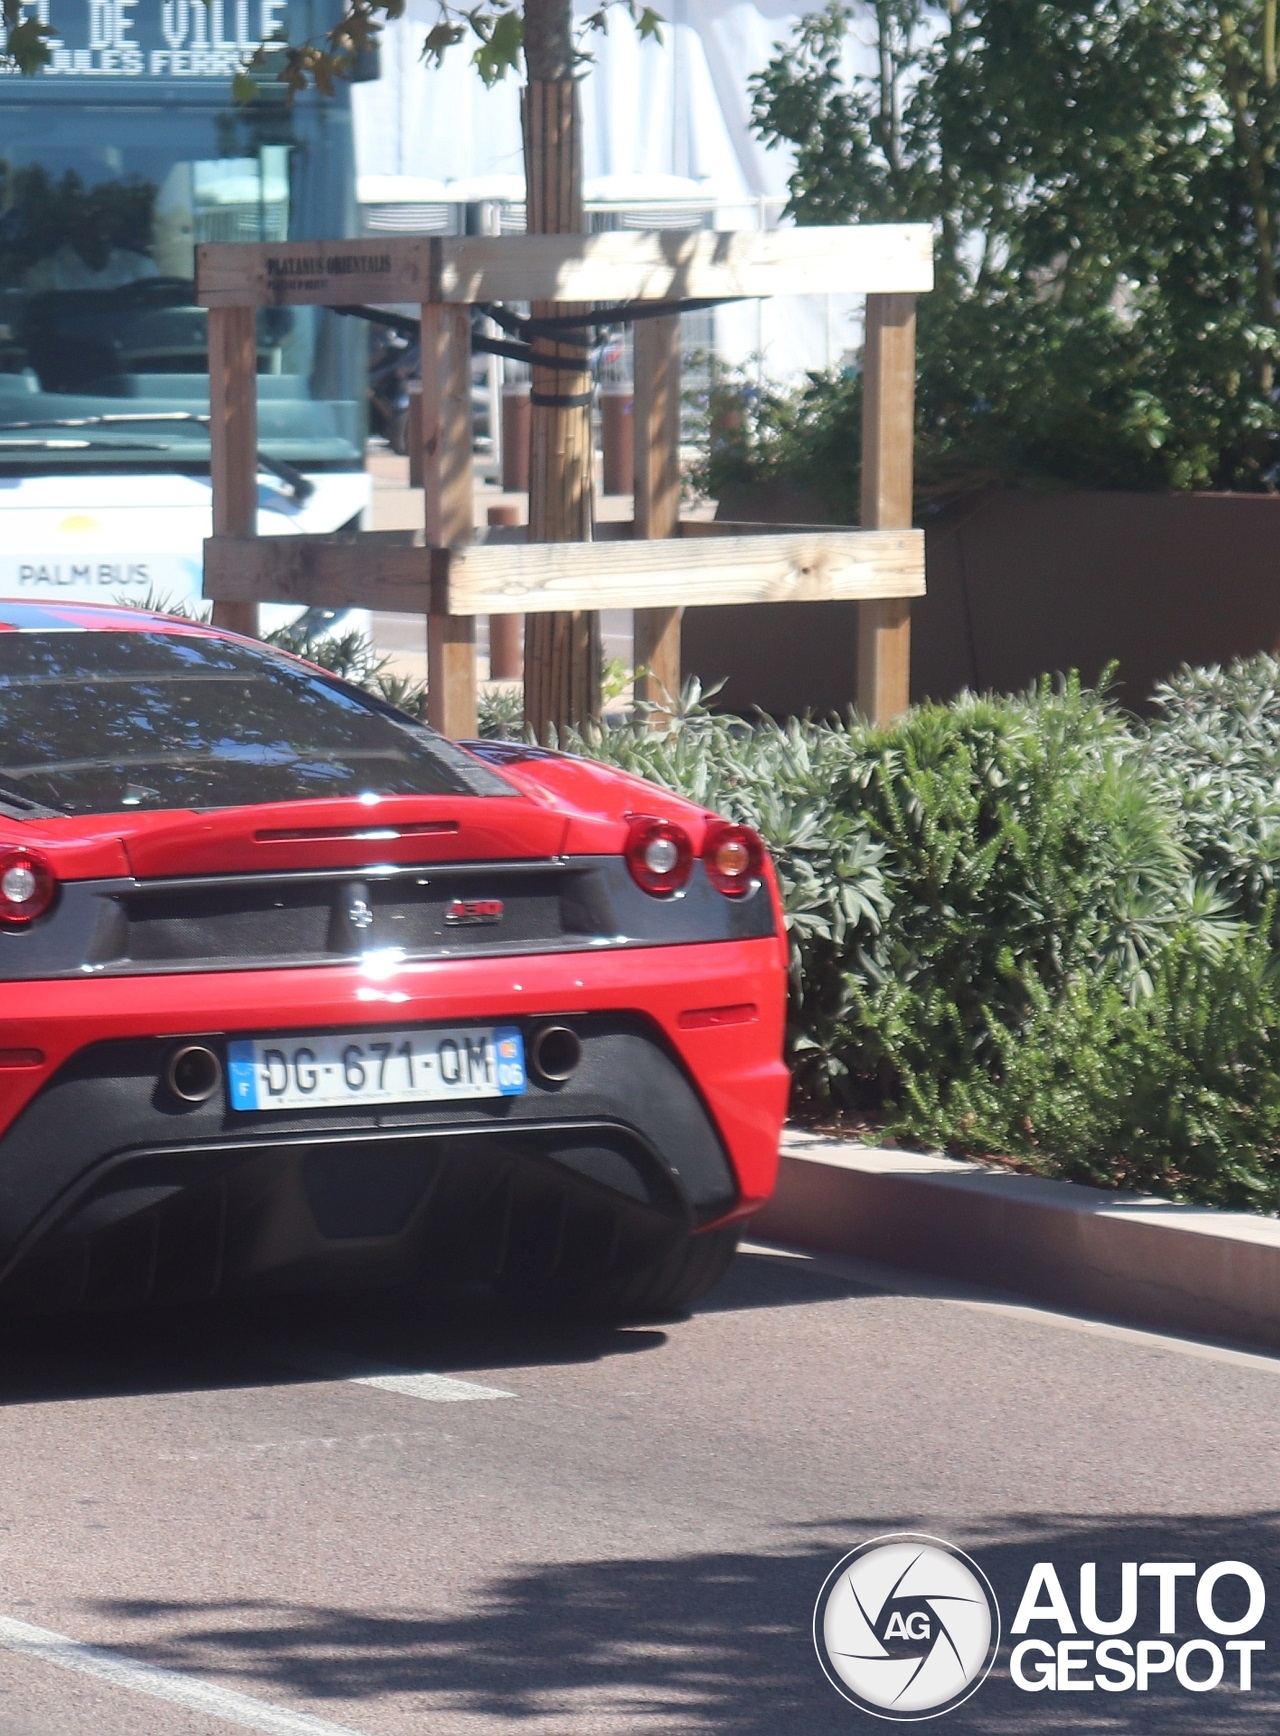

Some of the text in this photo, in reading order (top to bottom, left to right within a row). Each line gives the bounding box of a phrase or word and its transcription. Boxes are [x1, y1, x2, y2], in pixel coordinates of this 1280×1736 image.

[88, 0, 140, 50] DE
[162, 0, 289, 52] VILLE
[42, 49, 145, 76] JULES
[19, 563, 149, 586] PALM BUS
[239, 1082, 250, 1097] F
[263, 1036, 493, 1096] DG-671-QM
